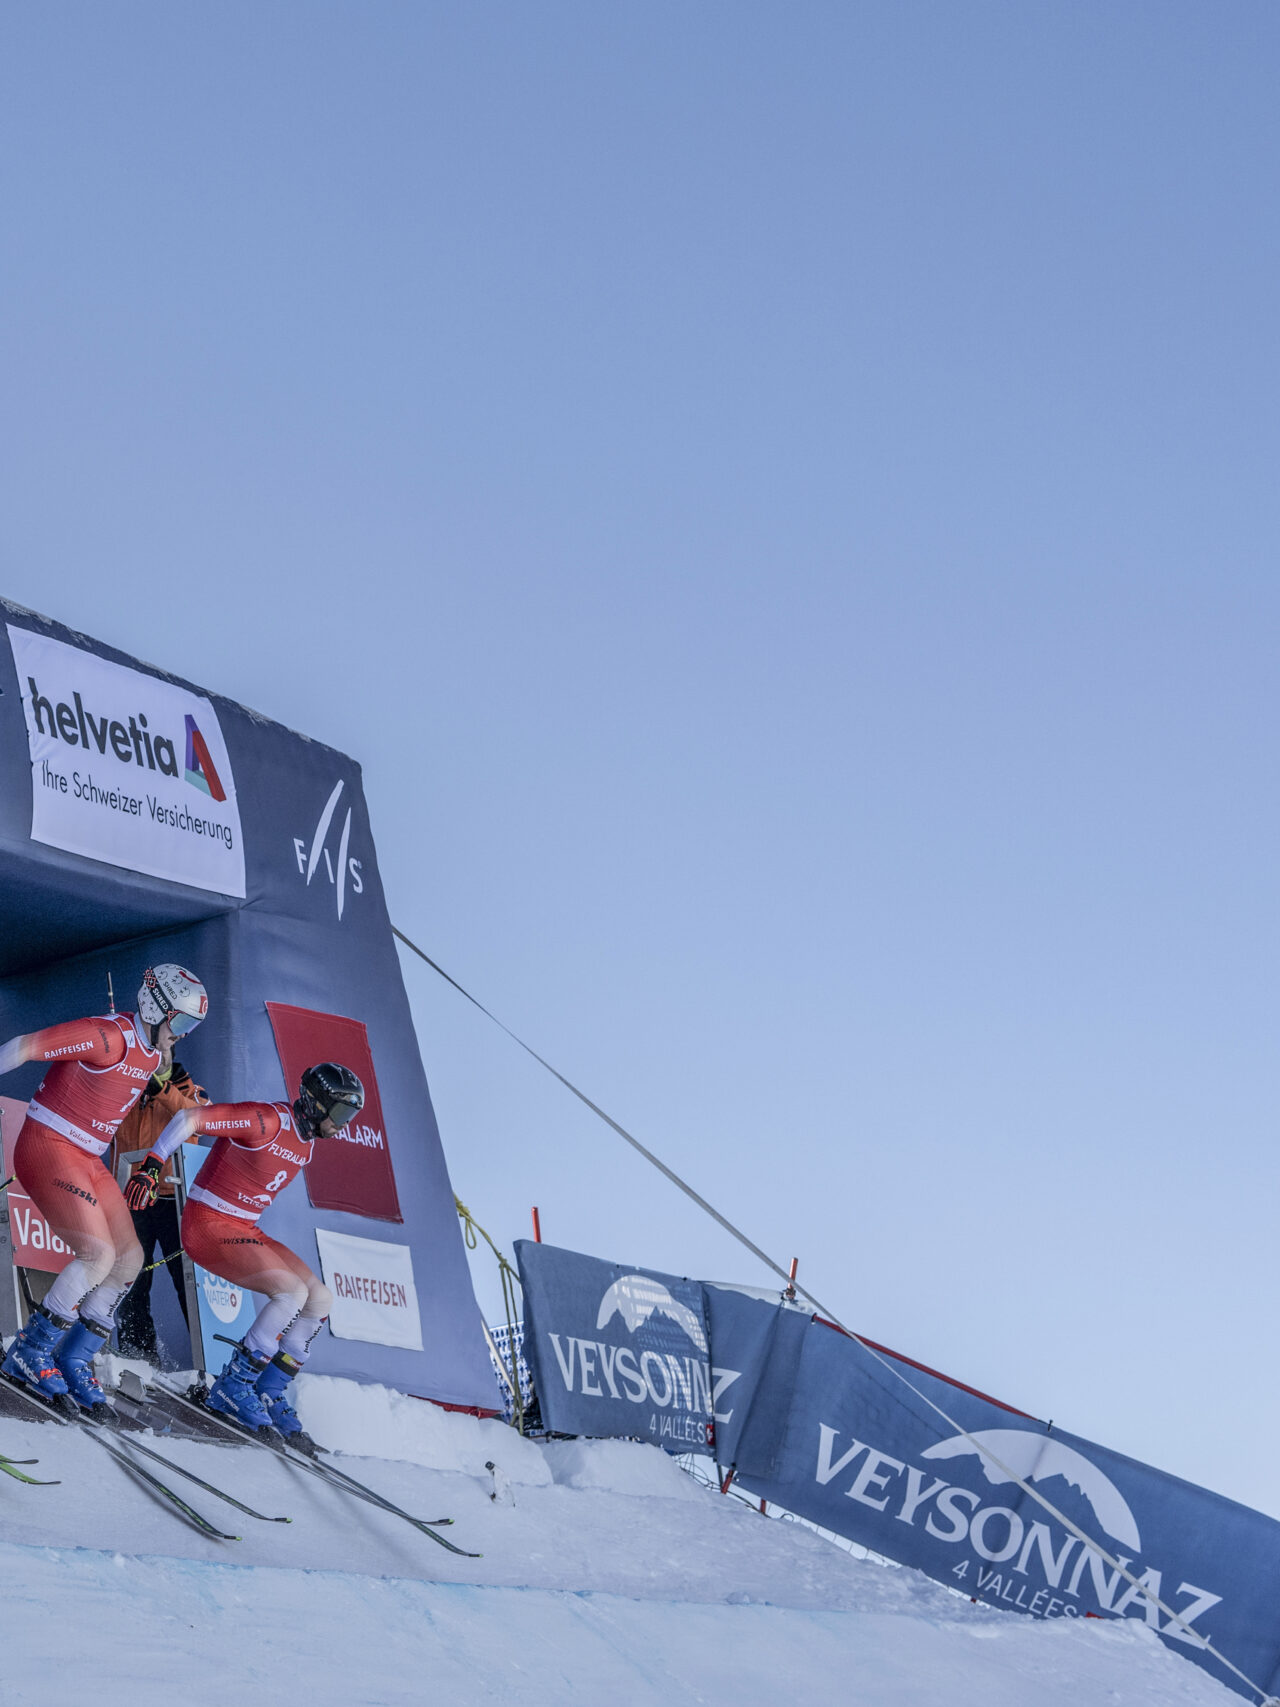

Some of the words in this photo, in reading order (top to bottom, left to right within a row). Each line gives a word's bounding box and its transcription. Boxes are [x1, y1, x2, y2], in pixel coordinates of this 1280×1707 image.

[27, 676, 179, 778] helvetia
[42, 759, 68, 793] Ihre
[72, 771, 143, 817] Schweizer
[146, 794, 233, 850] Versicherung
[152, 987, 169, 1010] SHRED
[44, 1040, 94, 1059] RAIFFEISEN
[120, 1087, 142, 1112] 7
[205, 1119, 251, 1130] RAIFFEISEN
[265, 1170, 287, 1192] 8
[333, 1272, 408, 1309] RAIFFEISEN
[649, 1413, 657, 1433] 4
[659, 1415, 706, 1444] VALLÉES
[815, 1422, 1224, 1650] VEYSONNAZ
[952, 1559, 970, 1580] 4
